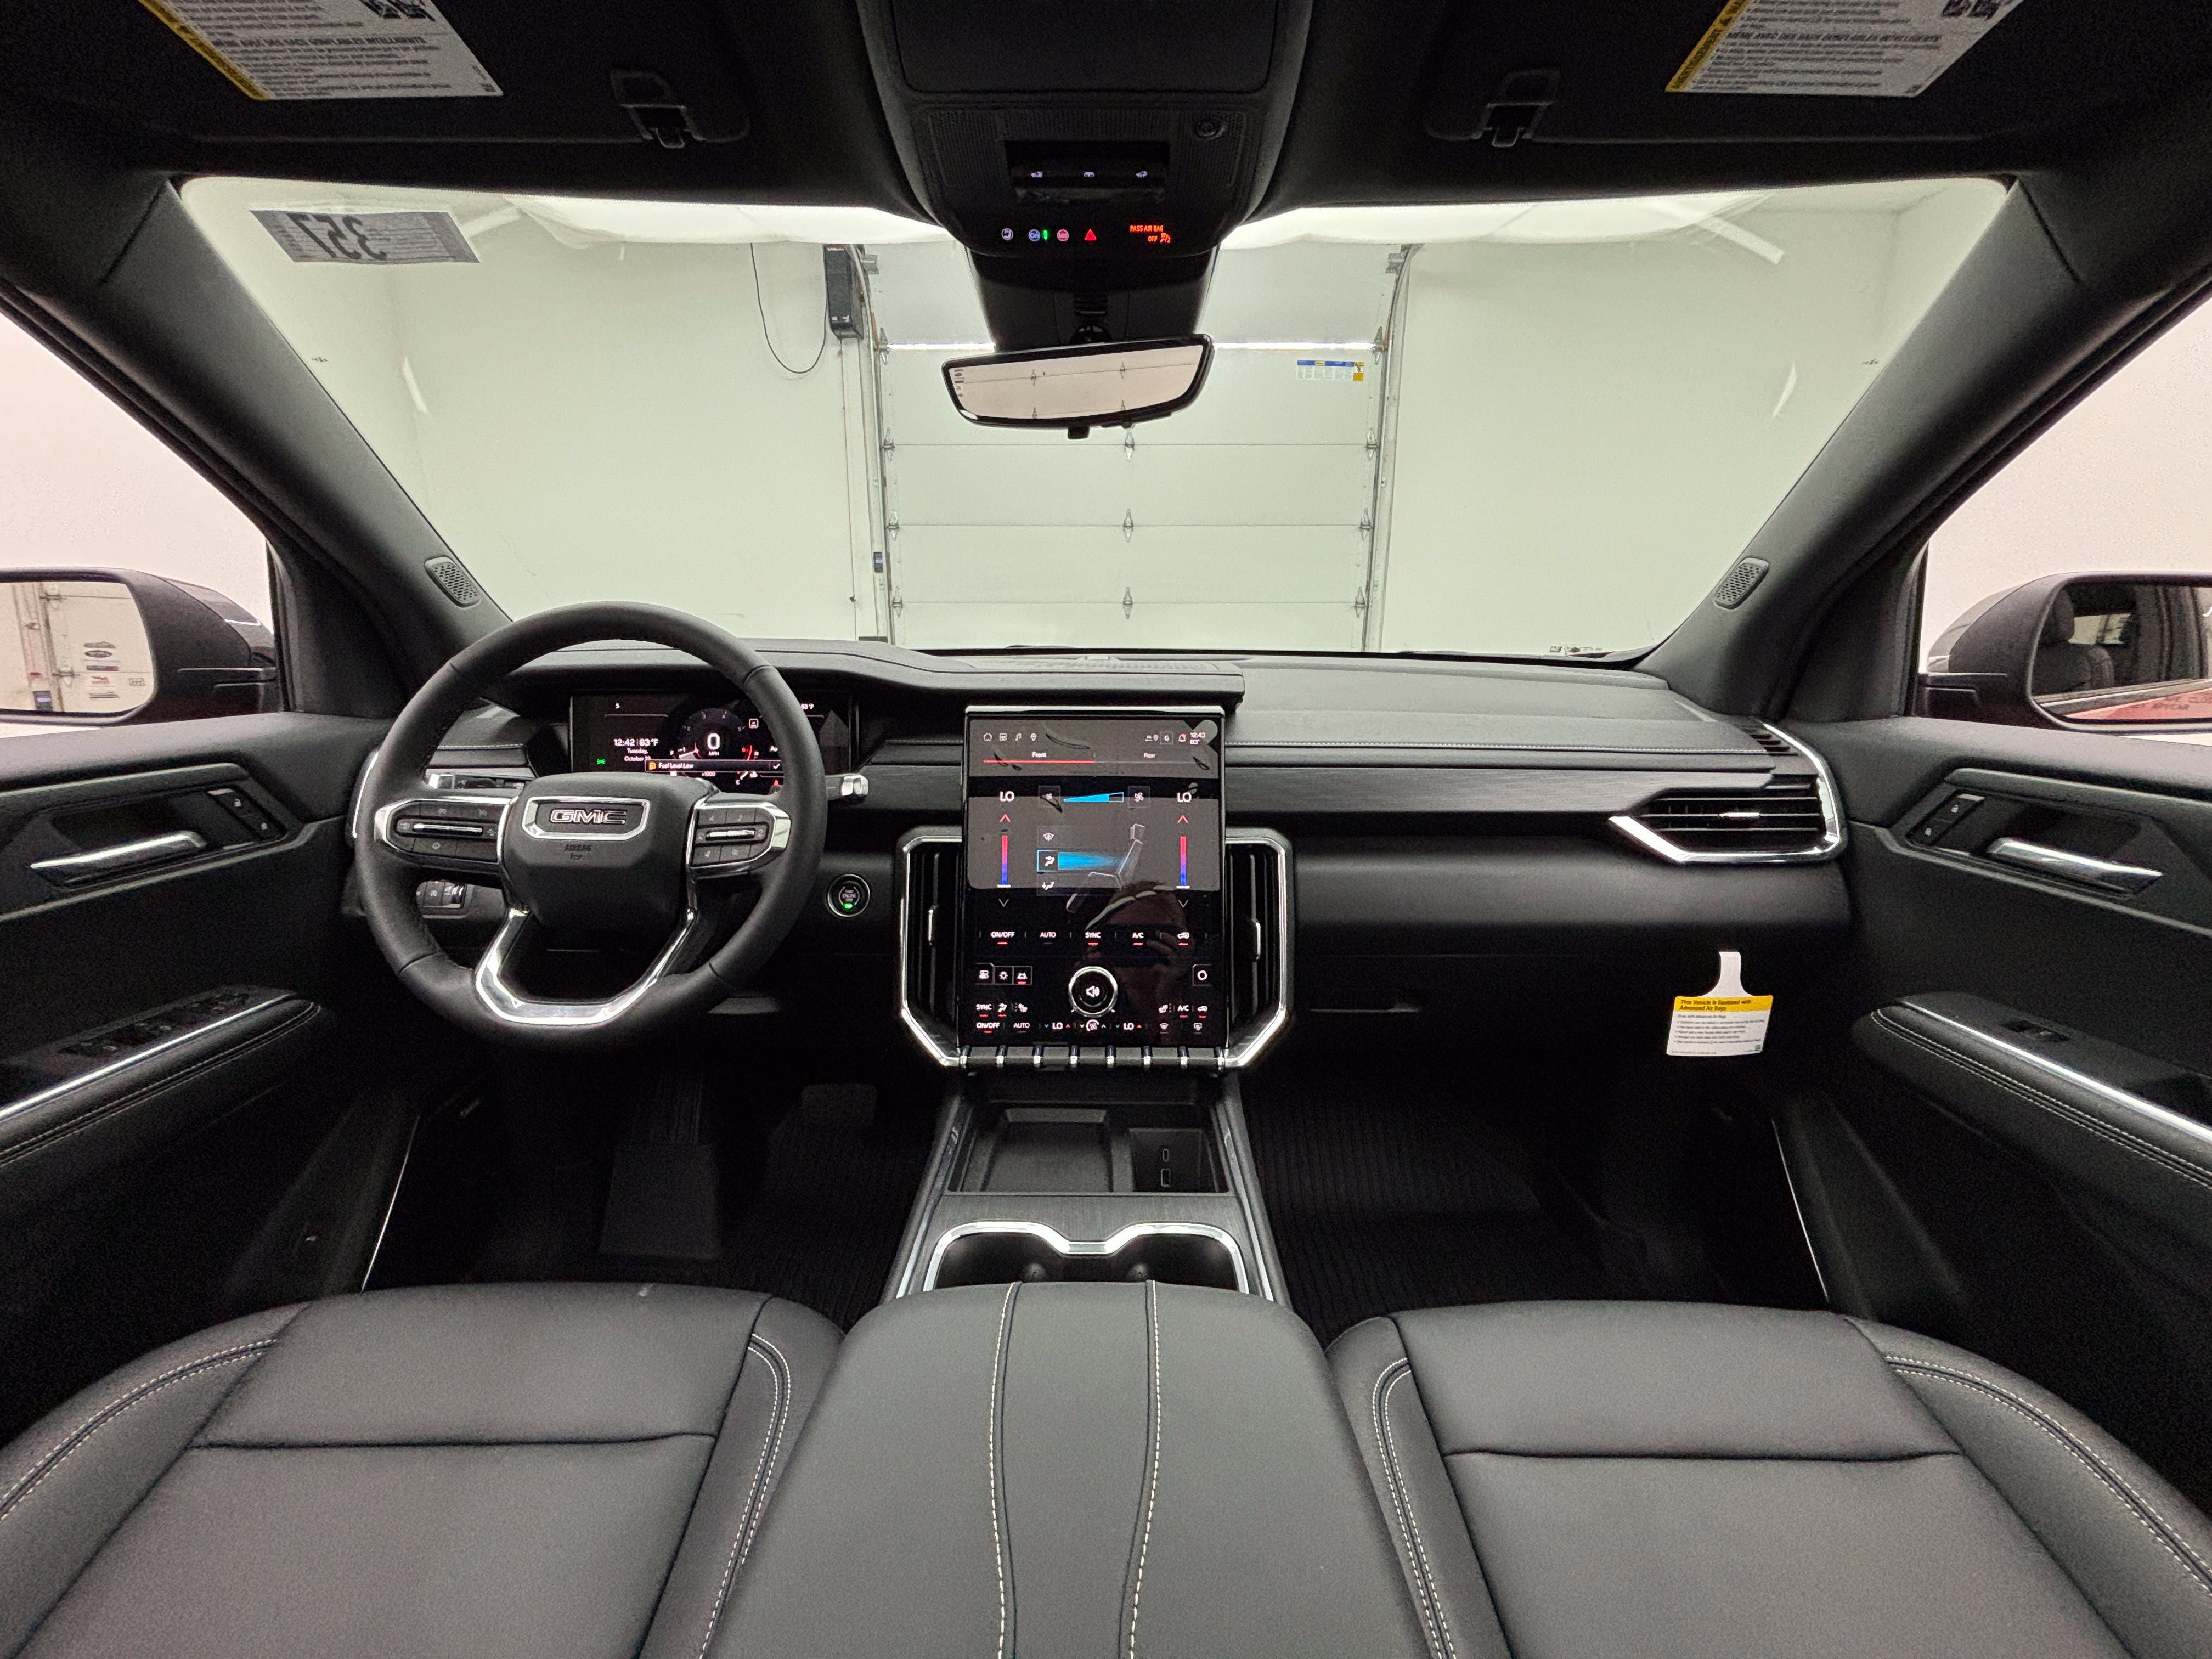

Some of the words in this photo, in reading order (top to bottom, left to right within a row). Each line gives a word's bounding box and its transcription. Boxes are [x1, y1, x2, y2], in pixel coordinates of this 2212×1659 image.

[613, 738, 635, 747] 12:42
[707, 732, 721, 750] 0
[1000, 791, 1015, 802] LO
[1177, 792, 1192, 803] LO
[550, 809, 627, 824] GMC
